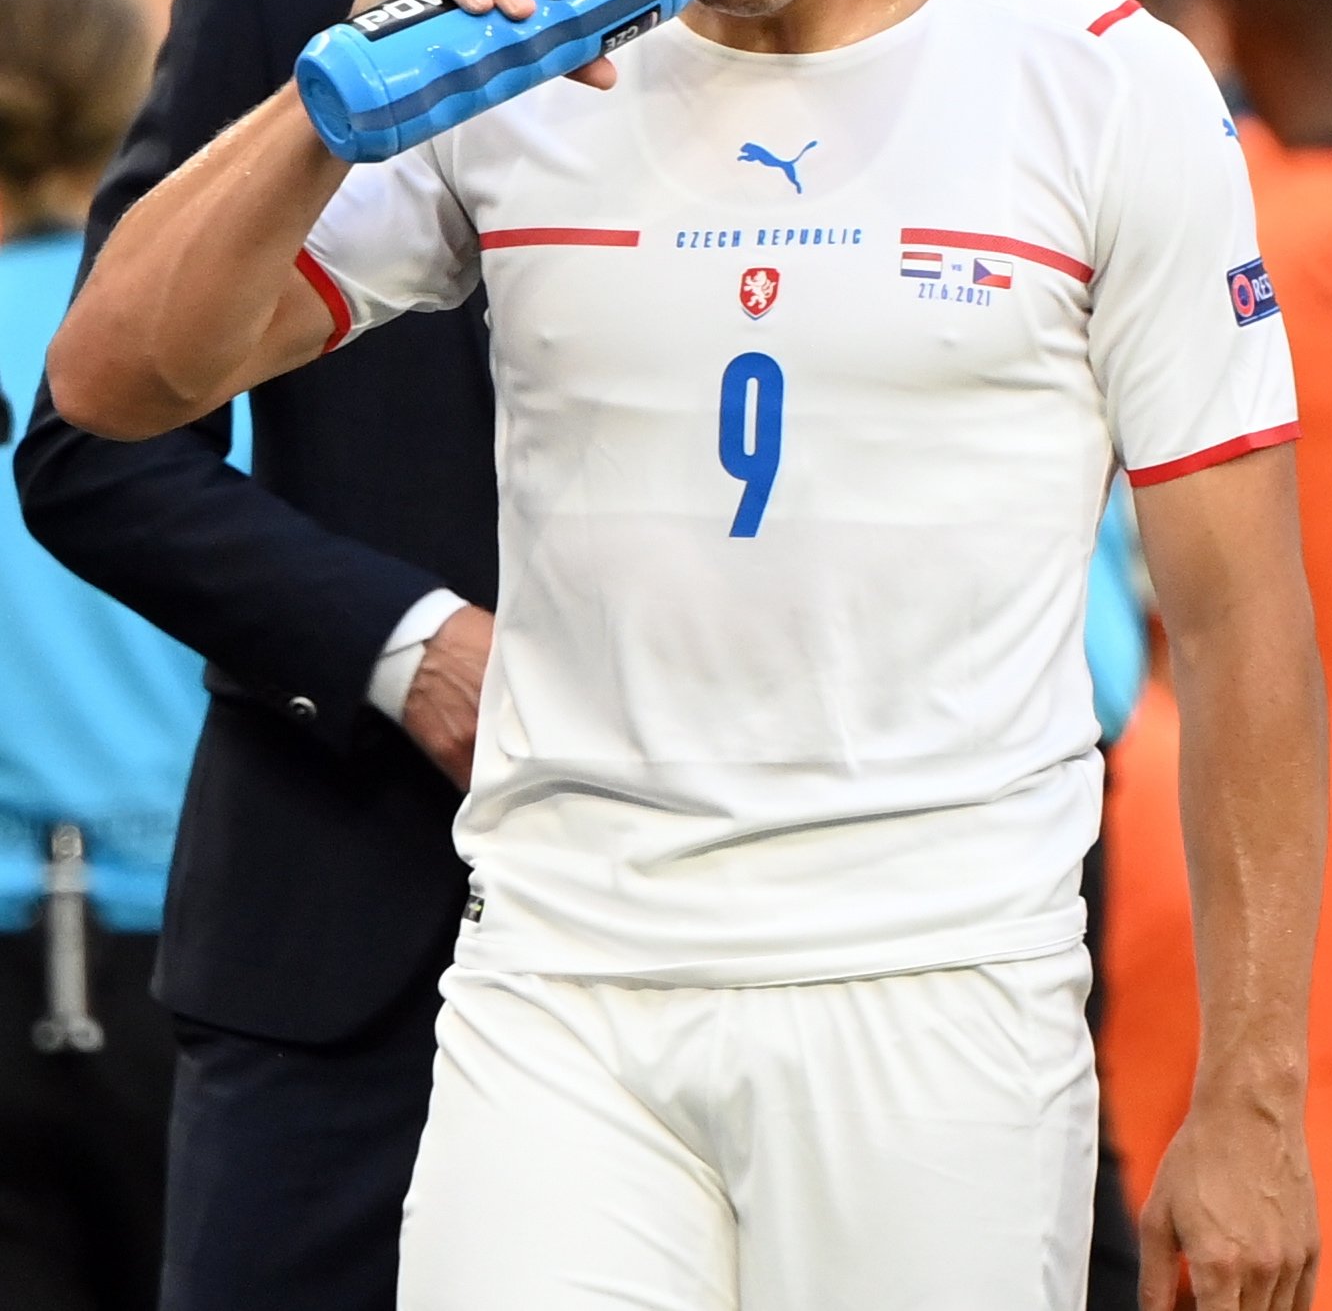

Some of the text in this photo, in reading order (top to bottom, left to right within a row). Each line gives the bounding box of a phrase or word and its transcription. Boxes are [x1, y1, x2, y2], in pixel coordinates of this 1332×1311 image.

[676, 228, 863, 249] CZECH REPUBLIC
[918, 282, 991, 307] 27.6.2021
[719, 351, 785, 538] 9
